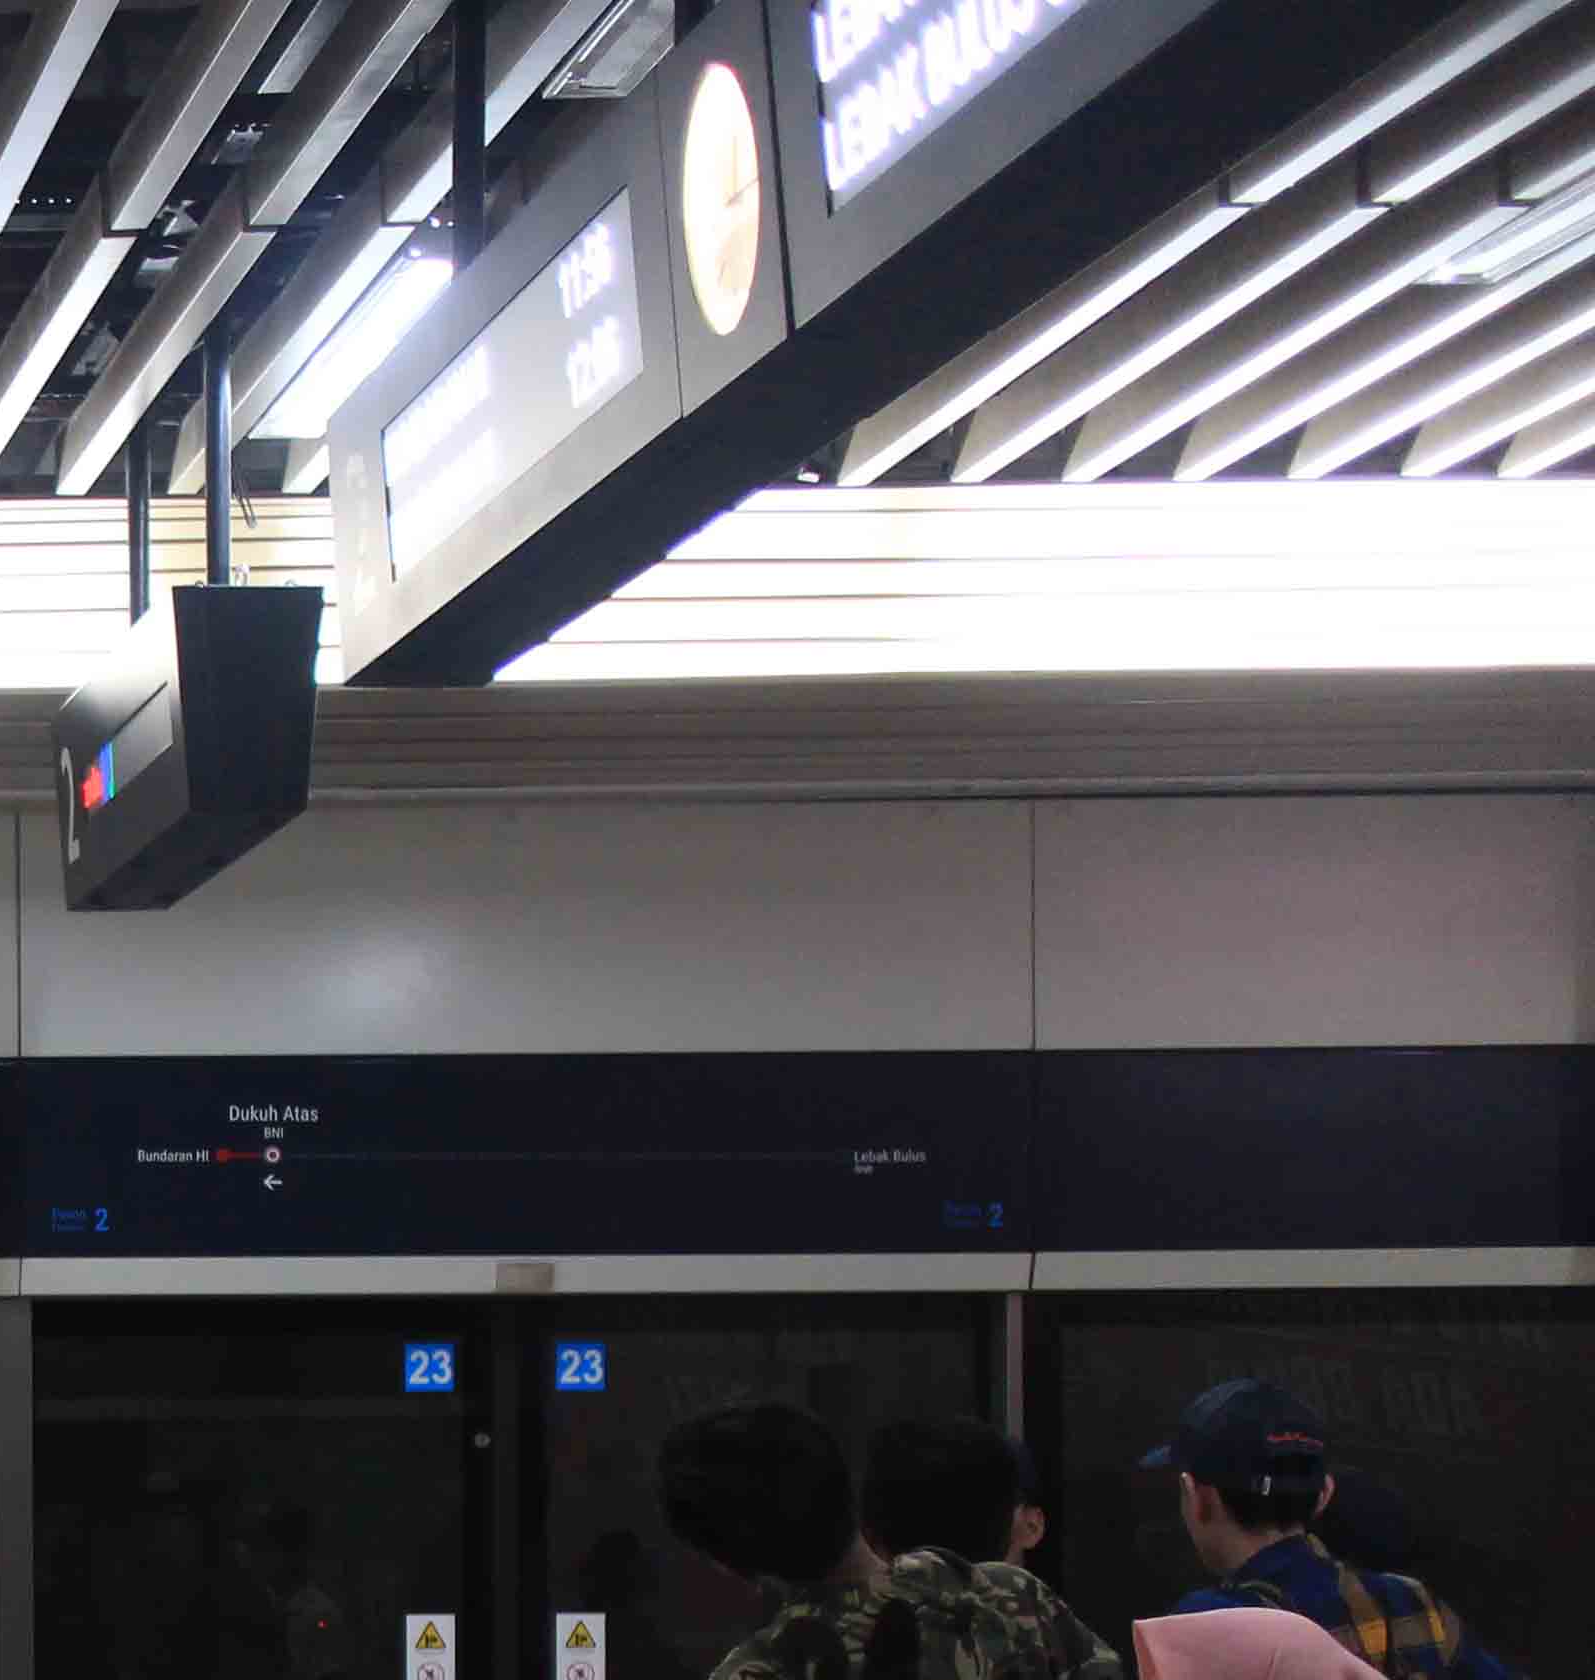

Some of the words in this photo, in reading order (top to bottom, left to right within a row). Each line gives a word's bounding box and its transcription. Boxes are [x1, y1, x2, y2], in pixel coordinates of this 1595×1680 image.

[230, 1105, 277, 1121] Dukuh
[283, 1106, 318, 1122] Atas
[264, 1127, 283, 1138] BNI
[137, 1149, 193, 1162] Bundaran
[196, 1149, 209, 1162] HI
[94, 1208, 109, 1233] 2
[410, 1350, 453, 1384] 23
[561, 1350, 603, 1384] 23
